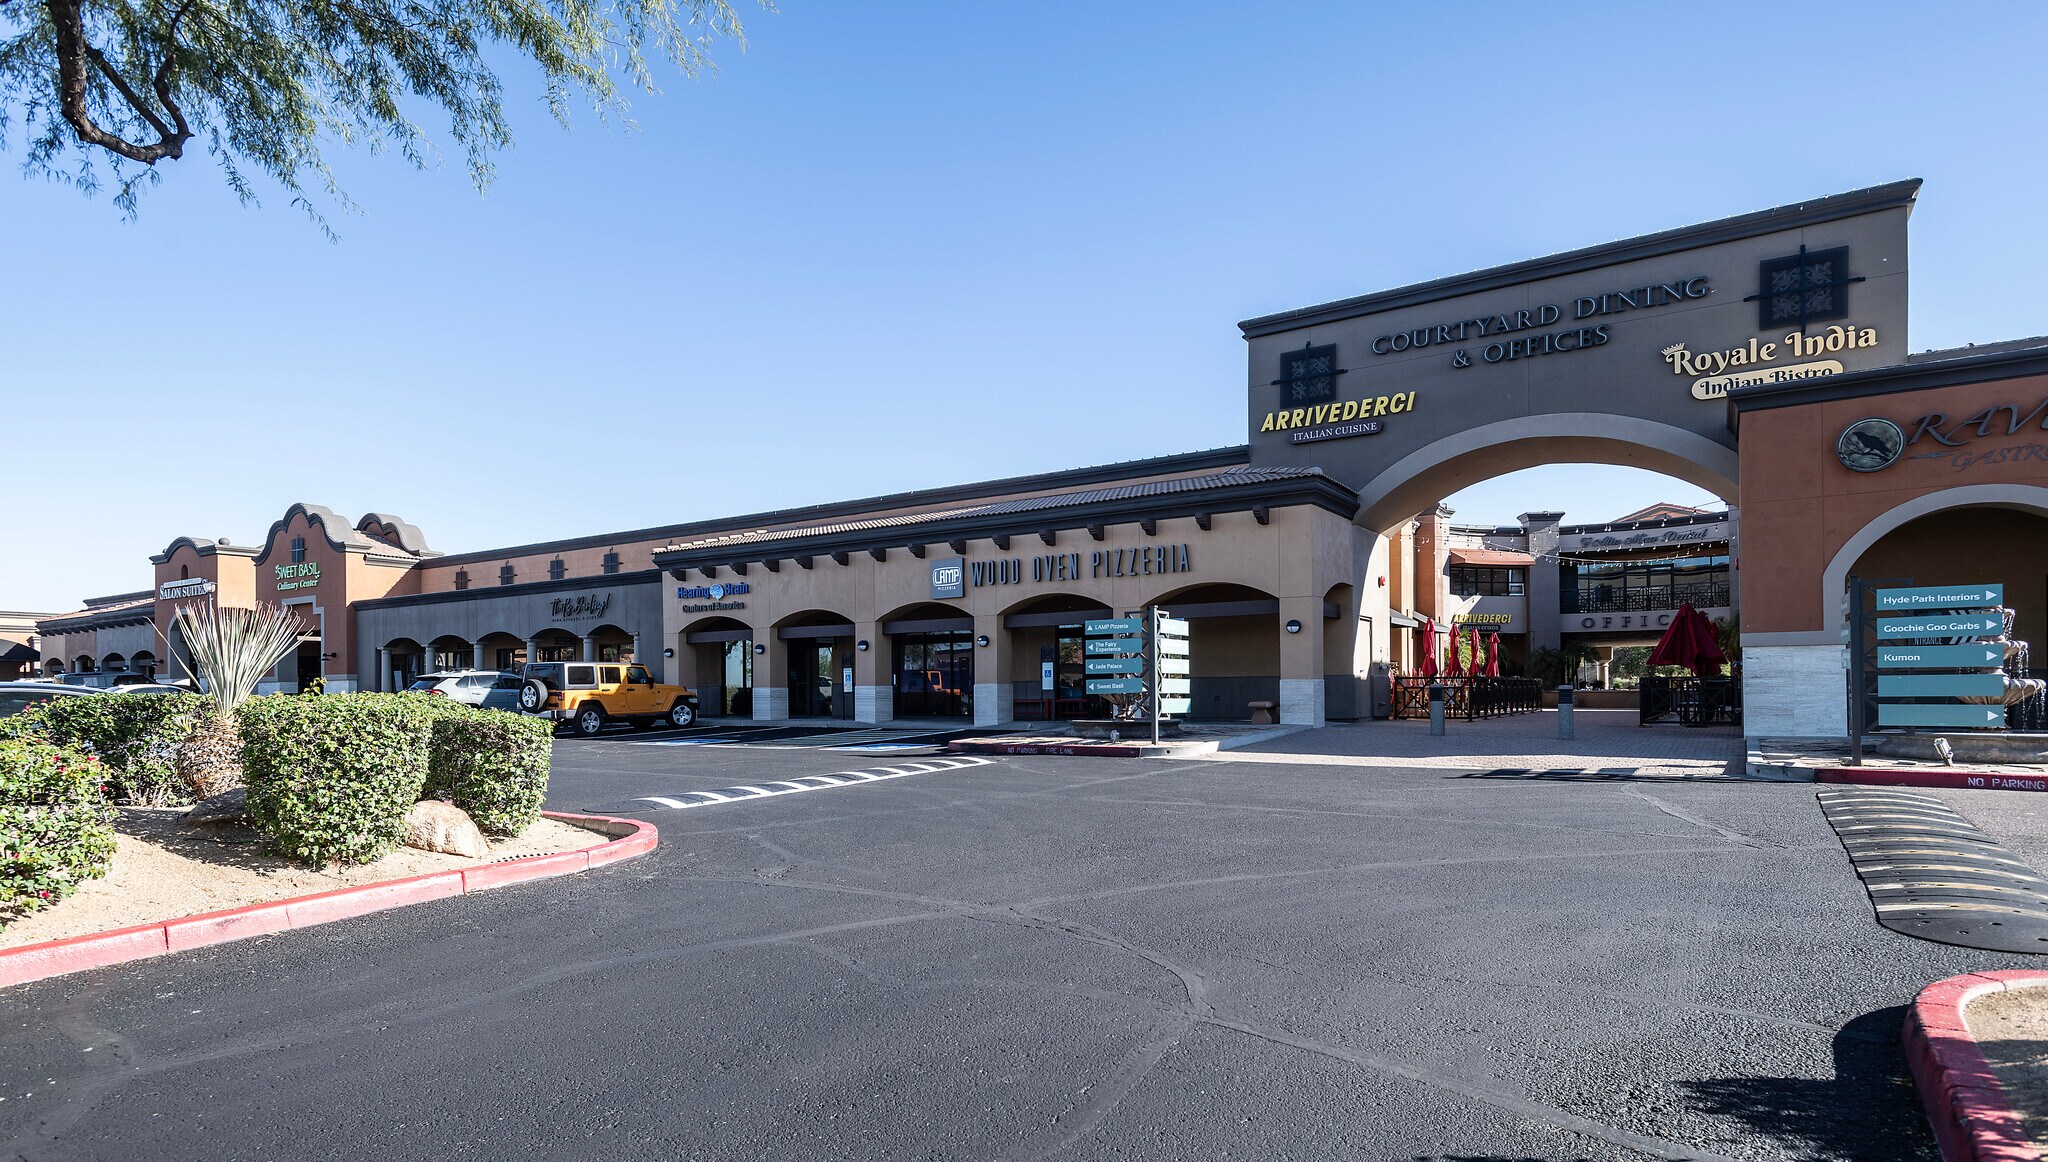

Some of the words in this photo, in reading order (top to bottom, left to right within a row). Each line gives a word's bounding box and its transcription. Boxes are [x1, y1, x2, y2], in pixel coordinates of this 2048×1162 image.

[1371, 305, 1560, 355] COURTYARD
[1573, 276, 1711, 320] DINING
[1453, 350, 1472, 369] &
[1483, 324, 1609, 363] OFFICES
[1662, 337, 1779, 376] Royale
[1784, 324, 1880, 357] India
[1699, 377, 1764, 396] Indian
[1260, 390, 1416, 432] ARRIVEDERCI
[1908, 397, 2048, 446] RAV
[1293, 428, 1336, 441] ITALIAN
[1335, 421, 1378, 435] CUISINE
[275, 564, 298, 580] SWEET
[298, 562, 318, 577] BASIL
[972, 558, 1020, 587] WOOD
[1033, 552, 1080, 582] OVEN
[1091, 543, 1191, 578] PIZZERIA
[299, 579, 318, 588] Center
[932, 566, 960, 586] LAMP
[160, 585, 182, 600] SALON
[677, 586, 711, 600] Hearing
[724, 582, 751, 595] Brain
[1884, 596, 1910, 606] Hyde
[1912, 593, 1935, 603] Park
[1937, 593, 1980, 601] Interiors
[716, 600, 745, 610] America
[1581, 614, 1670, 629] OFFIC
[1884, 624, 1924, 633] Goochie
[1926, 623, 1947, 631] Goo
[1949, 621, 1980, 630] Garbs
[1967, 777, 1984, 787] NO
[1992, 778, 2045, 790] PARKING
